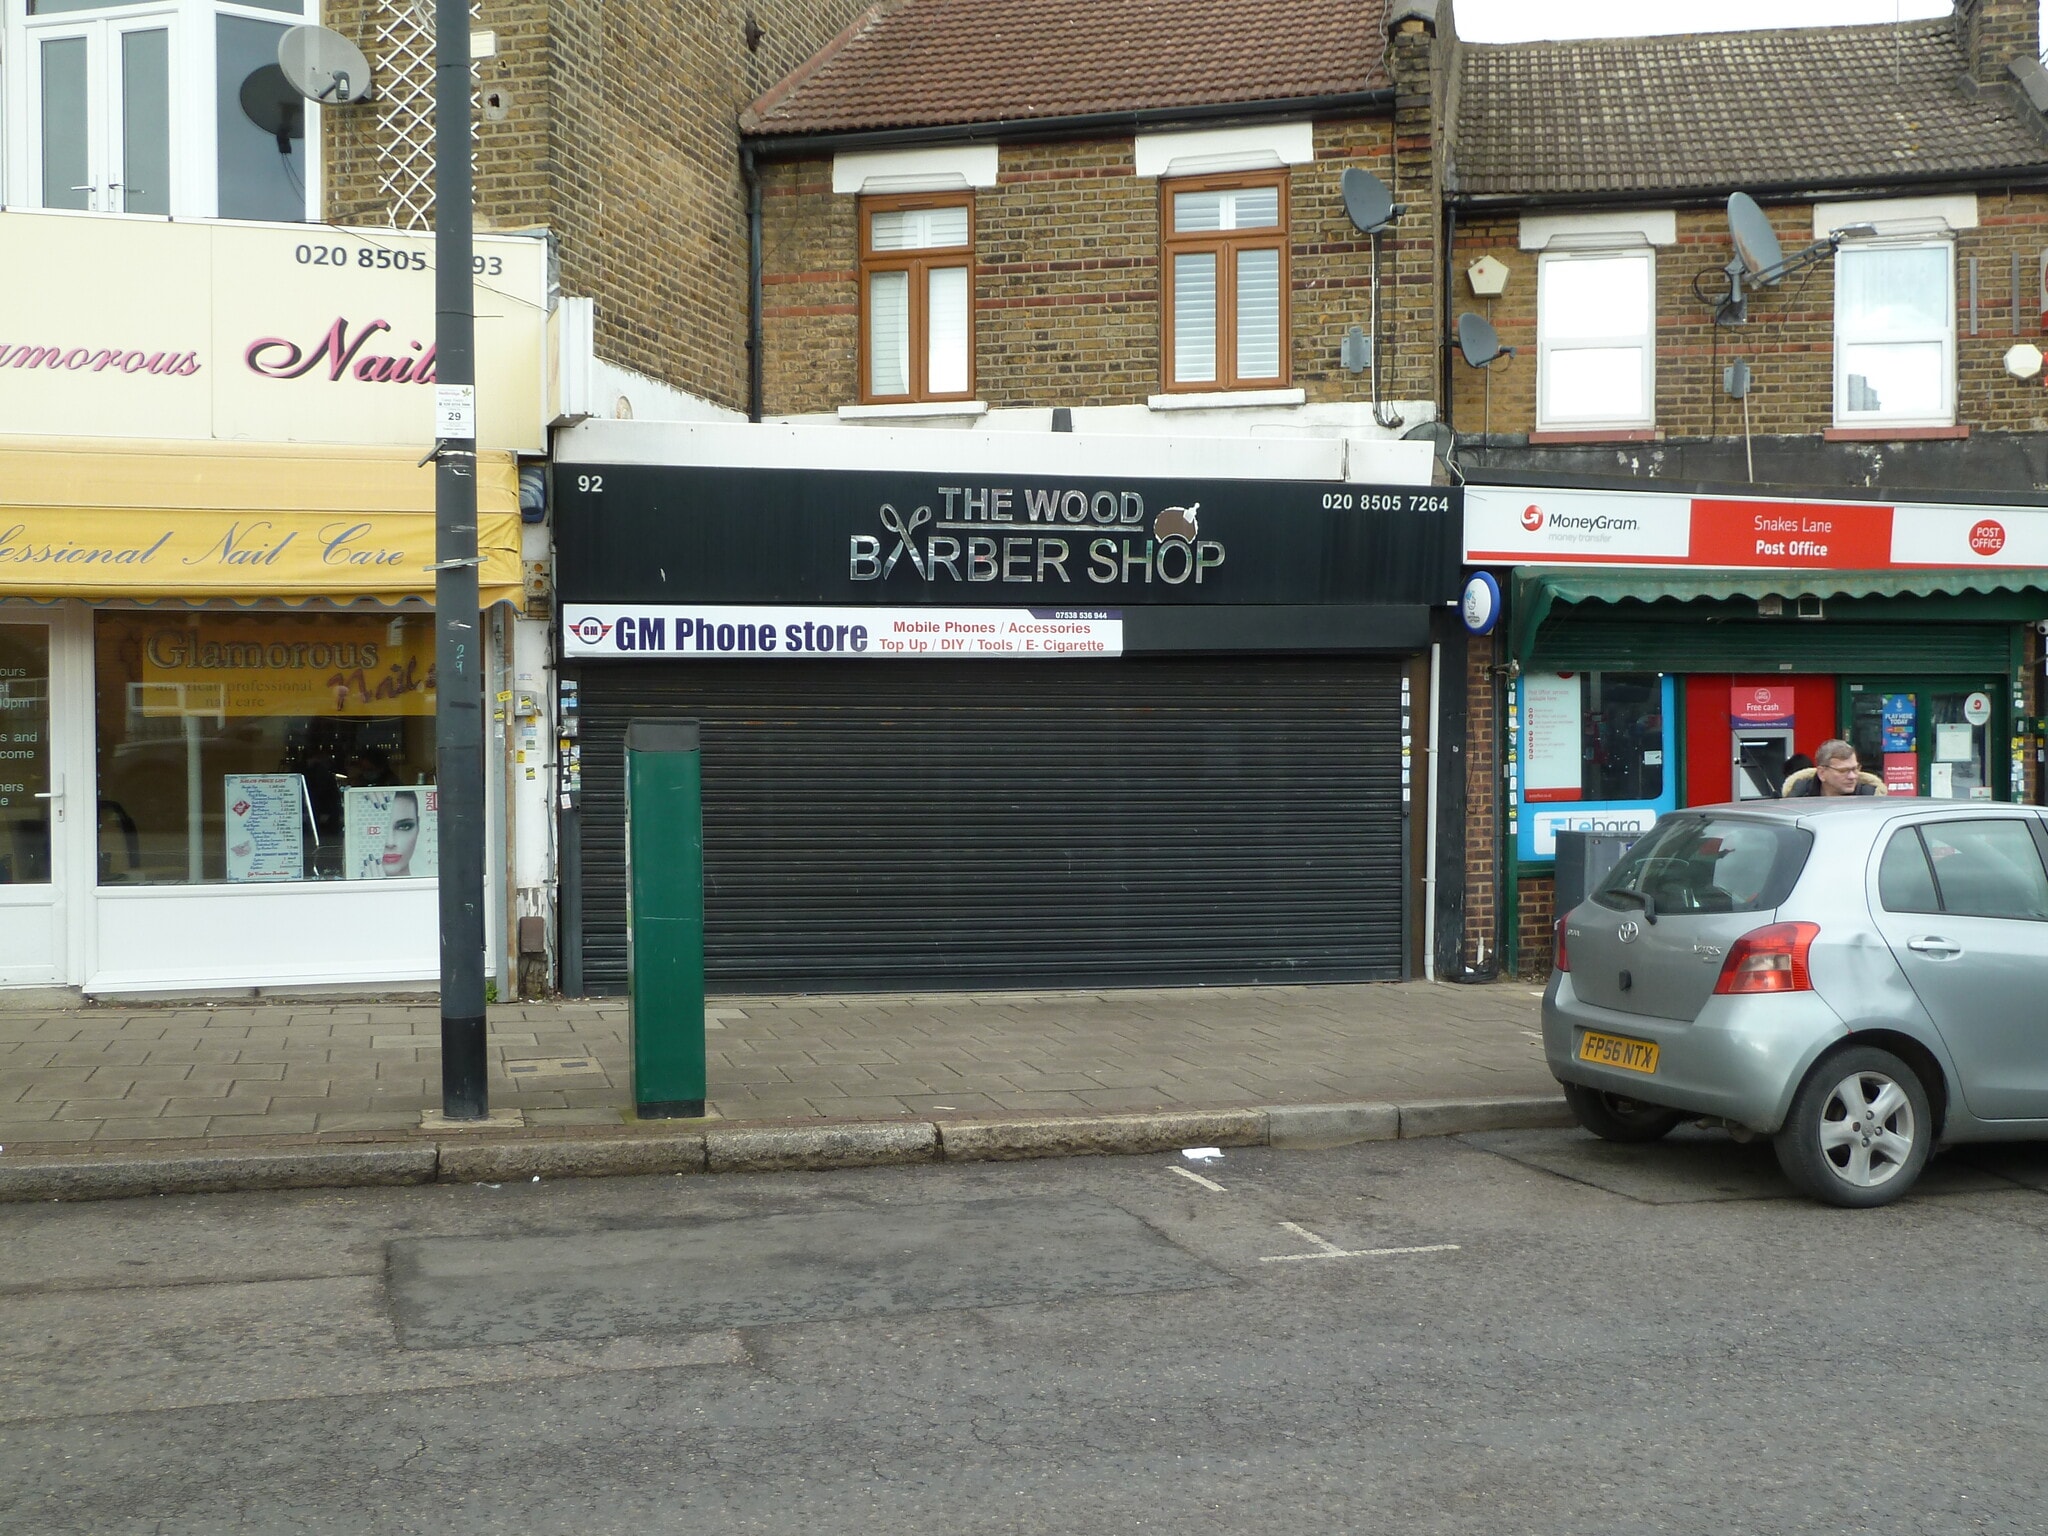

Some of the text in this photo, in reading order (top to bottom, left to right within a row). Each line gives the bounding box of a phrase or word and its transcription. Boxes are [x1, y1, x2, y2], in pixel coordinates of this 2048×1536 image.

[295, 244, 347, 266] 020
[358, 248, 427, 271] 8505
[244, 316, 437, 384] Nail
[448, 412, 461, 421] 29
[577, 475, 603, 492] 92
[938, 487, 1144, 524] THE WOOD
[1322, 493, 1449, 513] 020 8505 7264
[1549, 513, 1638, 533] MoneyGram
[1754, 515, 1832, 533] Snakes Lane
[1549, 533, 1613, 543] money transfer
[1976, 527, 2000, 538] POST
[182, 521, 299, 566] Nail
[318, 522, 405, 566] Care
[1756, 540, 1828, 556] Post Office
[1971, 538, 2002, 548] OFFICE
[1087, 538, 1226, 584] SHOP
[584, 626, 598, 636] GM
[615, 616, 868, 652] GM Phone store
[893, 621, 940, 633] Mobile
[945, 622, 996, 633] Phones
[1008, 622, 1091, 634] Accessories
[146, 628, 379, 670] Glamorous
[879, 638, 904, 653] Top
[908, 639, 928, 653] Up
[941, 639, 964, 651] DIY
[977, 639, 1013, 651] Tools
[1026, 639, 1039, 651] E-
[1043, 639, 1104, 653] Cigarette
[227, 680, 312, 693] professional
[235, 697, 265, 707] care
[1746, 702, 1779, 711] Free cash
[14, 732, 38, 742] and
[1585, 1036, 1654, 1069] FP56 NTX
